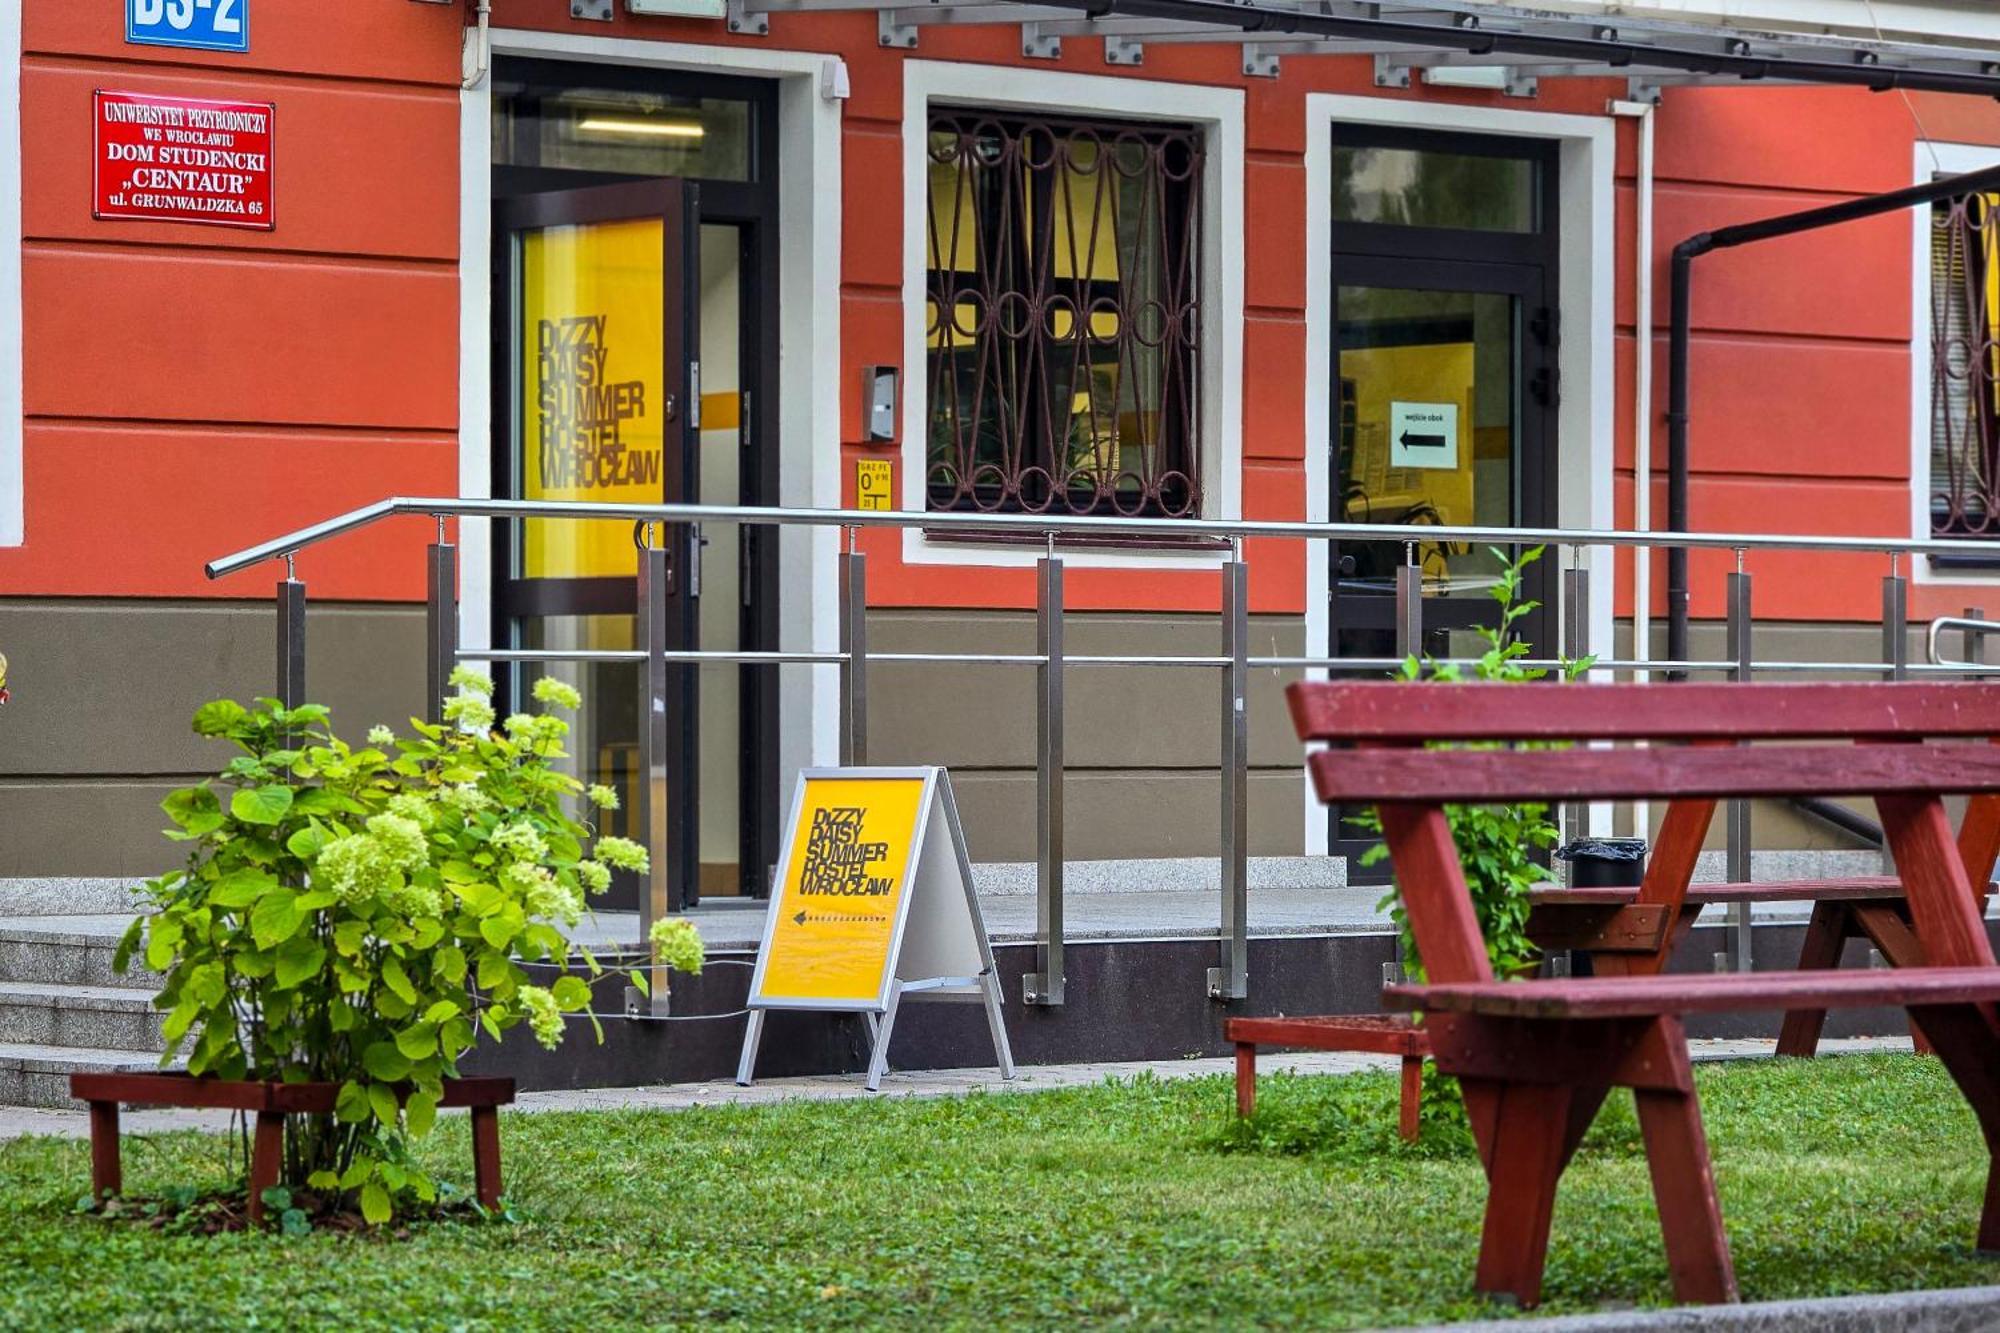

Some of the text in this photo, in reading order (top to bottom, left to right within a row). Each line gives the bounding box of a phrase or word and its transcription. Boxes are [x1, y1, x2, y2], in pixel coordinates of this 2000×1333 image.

[104, 102, 267, 134] UNIWERSYTET PRZYRODNICZY
[143, 127, 162, 141] WE
[107, 142, 266, 172] DOM STUDENCKI
[109, 192, 263, 215] ul. GRUNWALDZKA 65
[538, 380, 645, 424] SUMMER
[539, 413, 626, 452] HOSTEL
[539, 448, 660, 490] WROCŁAW
[809, 823, 864, 845] DAISY
[806, 842, 888, 863] SUMMER
[802, 856, 868, 880] HOSTEL
[799, 876, 894, 896] WROCŁAW
